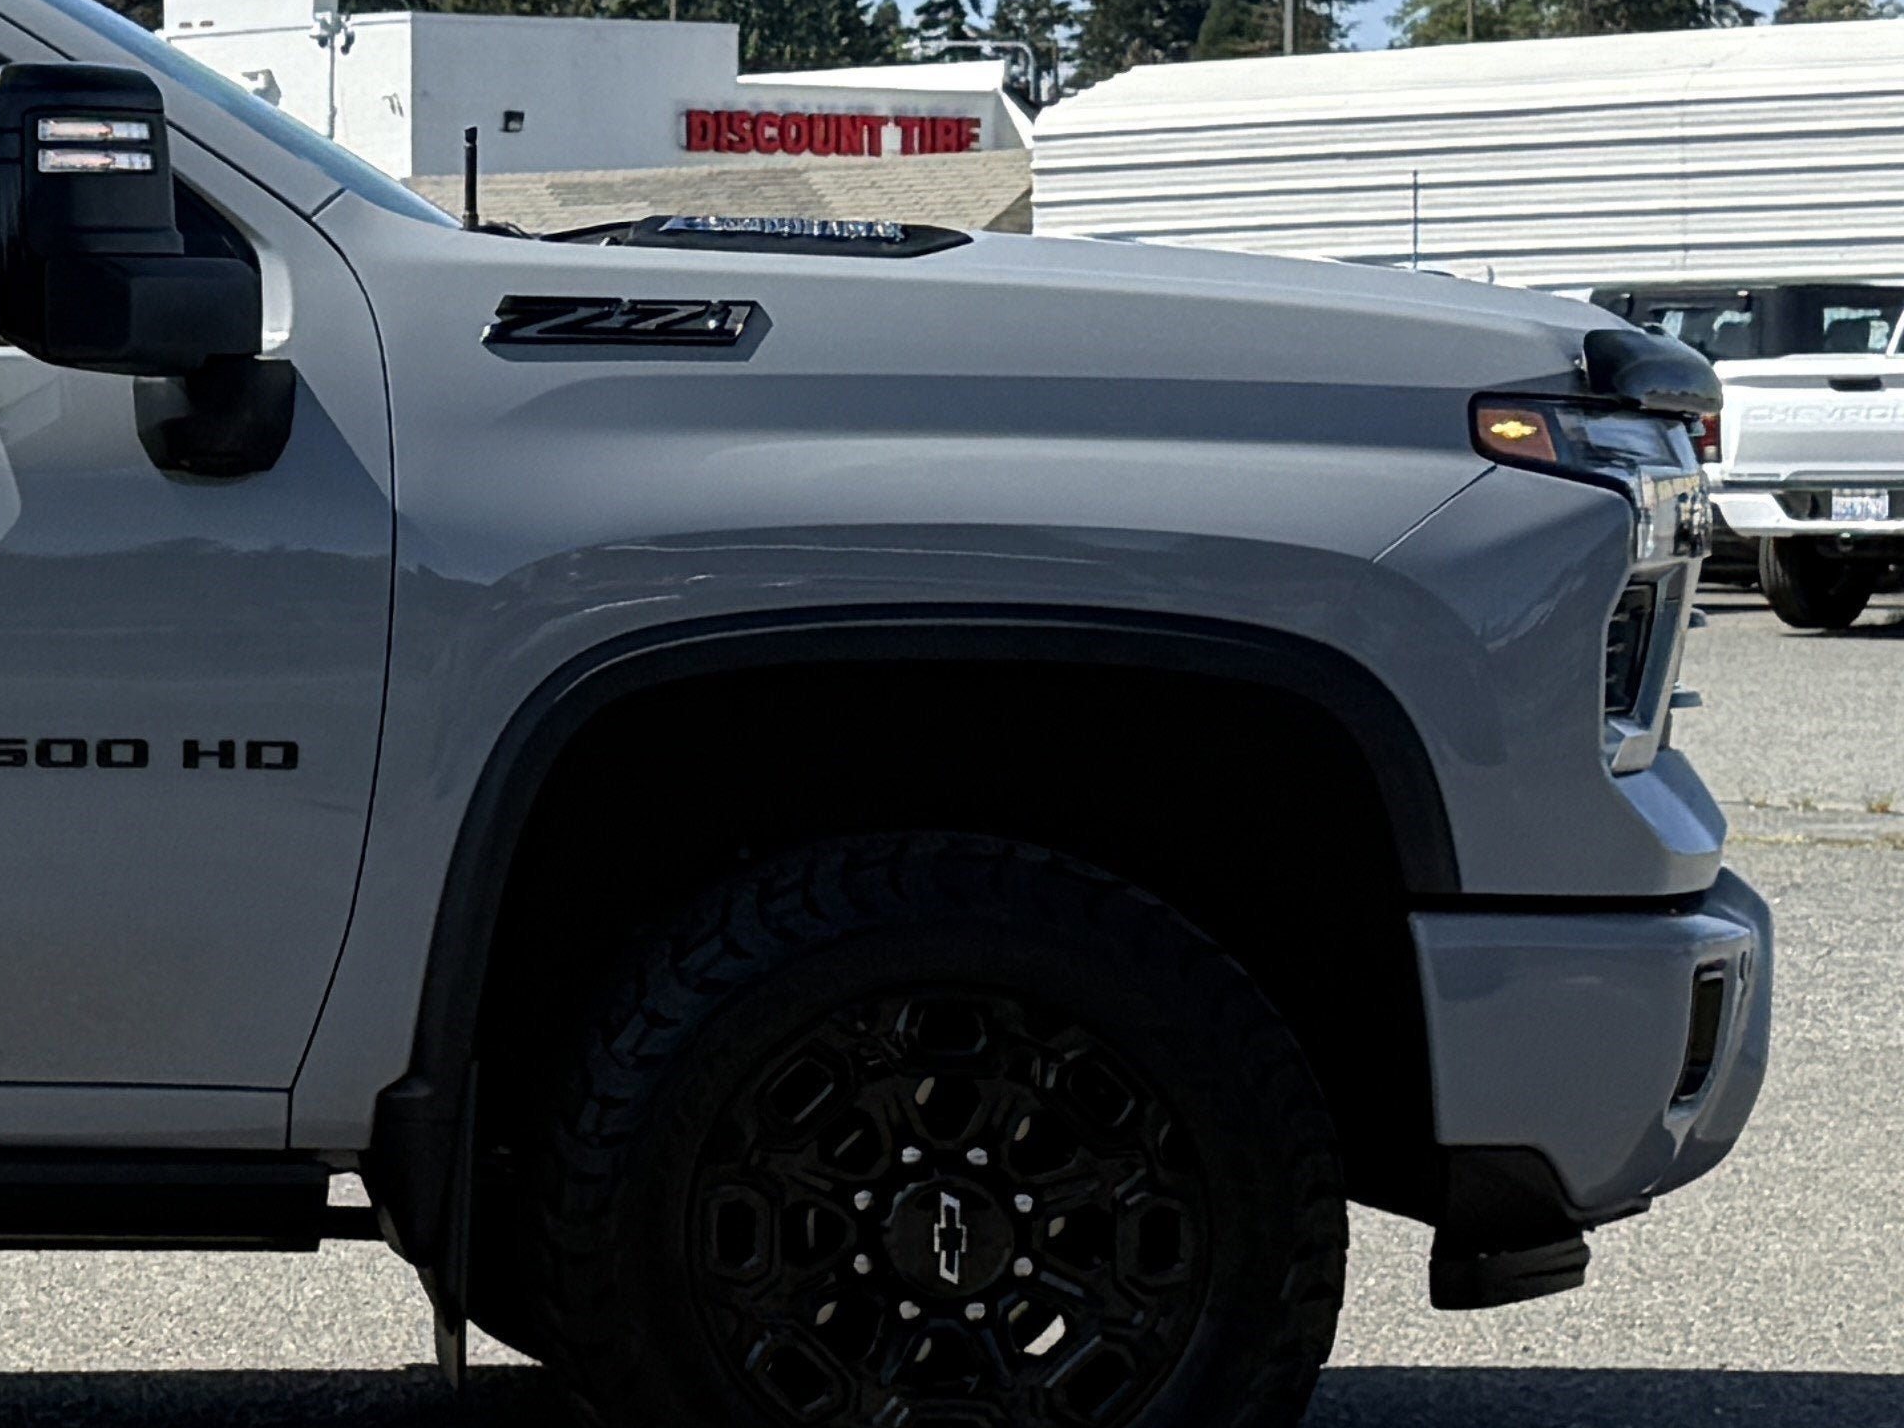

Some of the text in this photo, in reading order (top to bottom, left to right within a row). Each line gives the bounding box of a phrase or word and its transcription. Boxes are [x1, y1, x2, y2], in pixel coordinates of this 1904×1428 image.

[686, 109, 982, 158] DISCOUNT TIRE
[482, 294, 760, 347] Z71
[182, 739, 300, 771] HD
